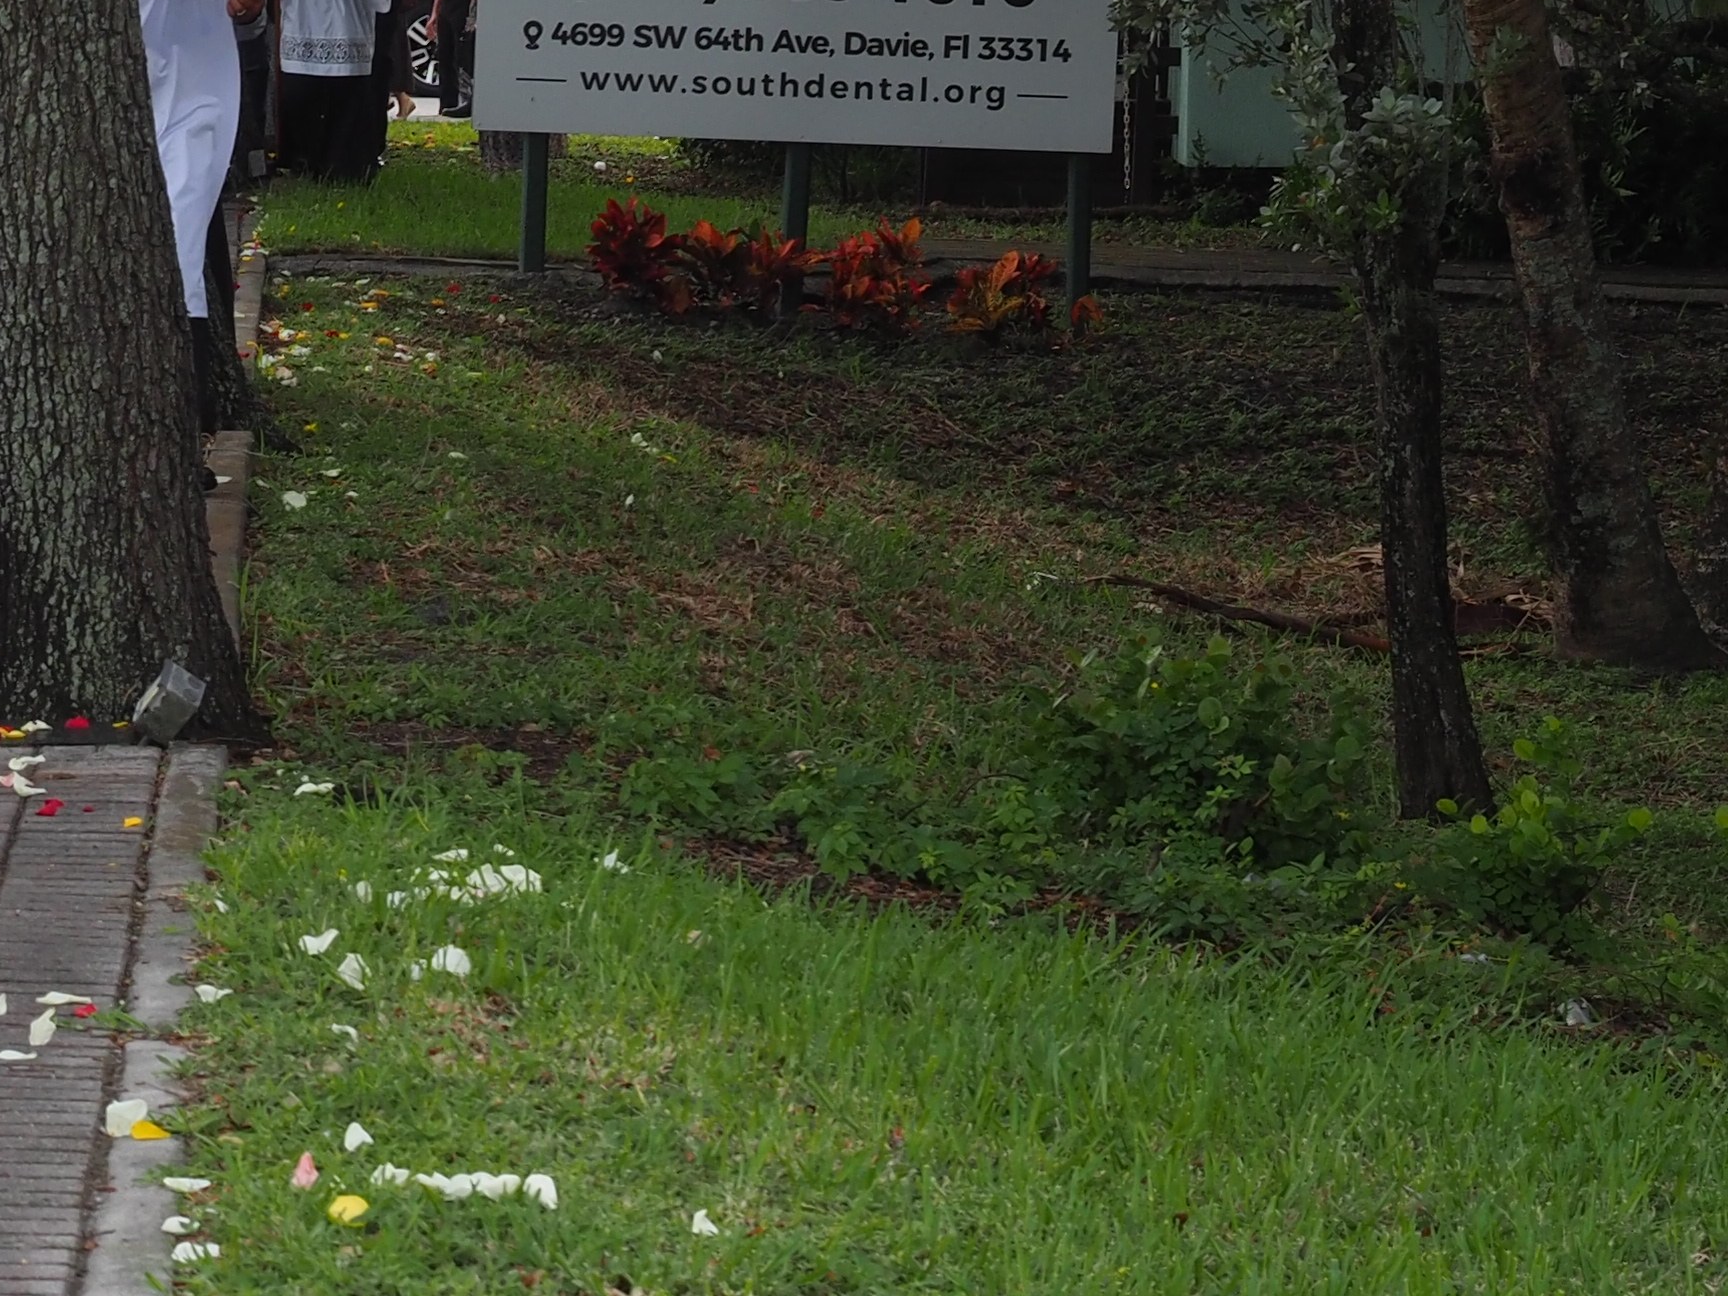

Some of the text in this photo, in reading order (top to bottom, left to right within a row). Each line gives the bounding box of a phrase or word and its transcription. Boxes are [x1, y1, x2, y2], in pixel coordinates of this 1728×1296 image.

[551, 22, 625, 47] 4699
[633, 24, 687, 49] SW
[694, 26, 763, 52] 64th
[771, 29, 835, 58] Ave,
[844, 31, 935, 61] Davie,
[977, 36, 1072, 63] 33314
[580, 71, 1006, 110] www.southdental.org
